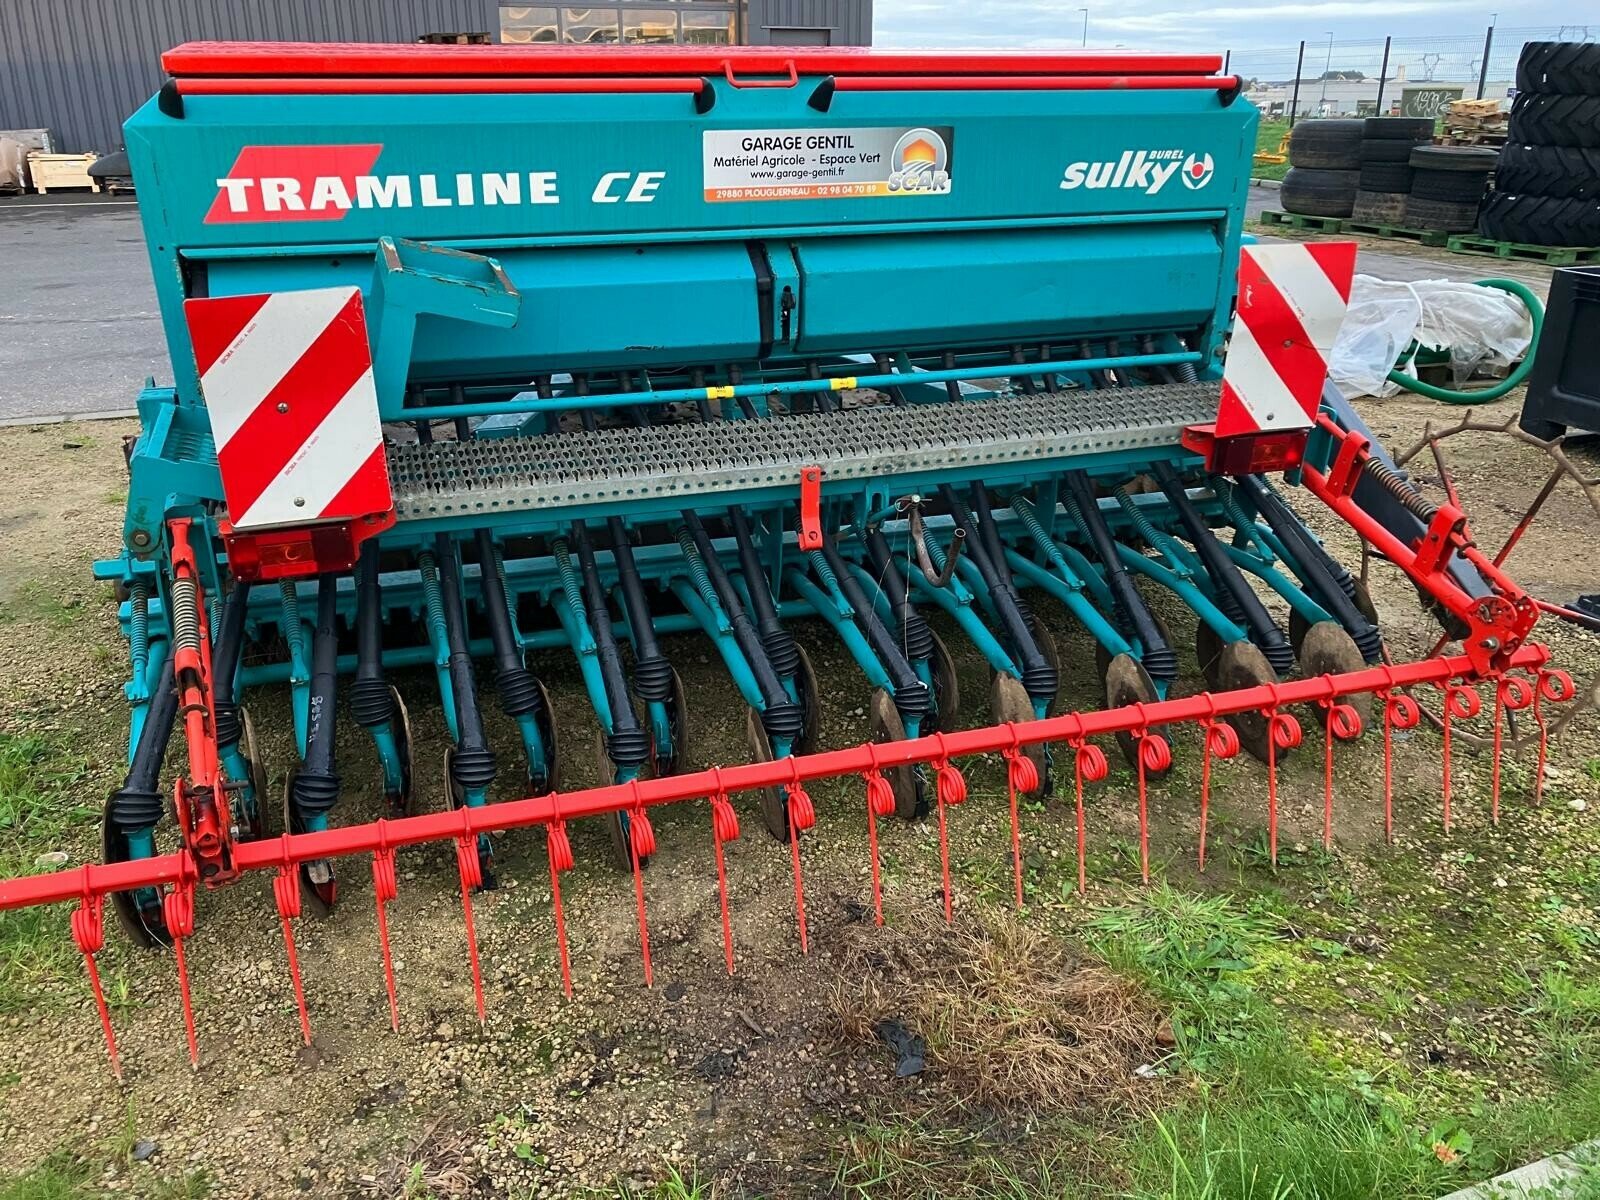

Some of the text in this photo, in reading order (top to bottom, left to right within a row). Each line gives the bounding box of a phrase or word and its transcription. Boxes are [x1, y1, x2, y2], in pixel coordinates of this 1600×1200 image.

[741, 136, 854, 151] GARAGE GENTIL
[713, 156, 759, 168] Matériel
[762, 156, 806, 168] Agricole
[819, 155, 856, 167] Espace
[859, 153, 881, 163] Vert
[1149, 149, 1184, 160] BUREL
[750, 168, 845, 179] www.garage-gentil.fr
[1060, 150, 1181, 194] sulky
[888, 170, 951, 193] SCAR
[216, 171, 666, 213] TRAMLINE CE
[716, 189, 743, 198] 29880
[744, 187, 811, 197] PLOUGUERNEAU
[817, 187, 828, 195] 02
[830, 186, 842, 195] 98
[843, 186, 855, 194] 04
[855, 186, 864, 194] 70
